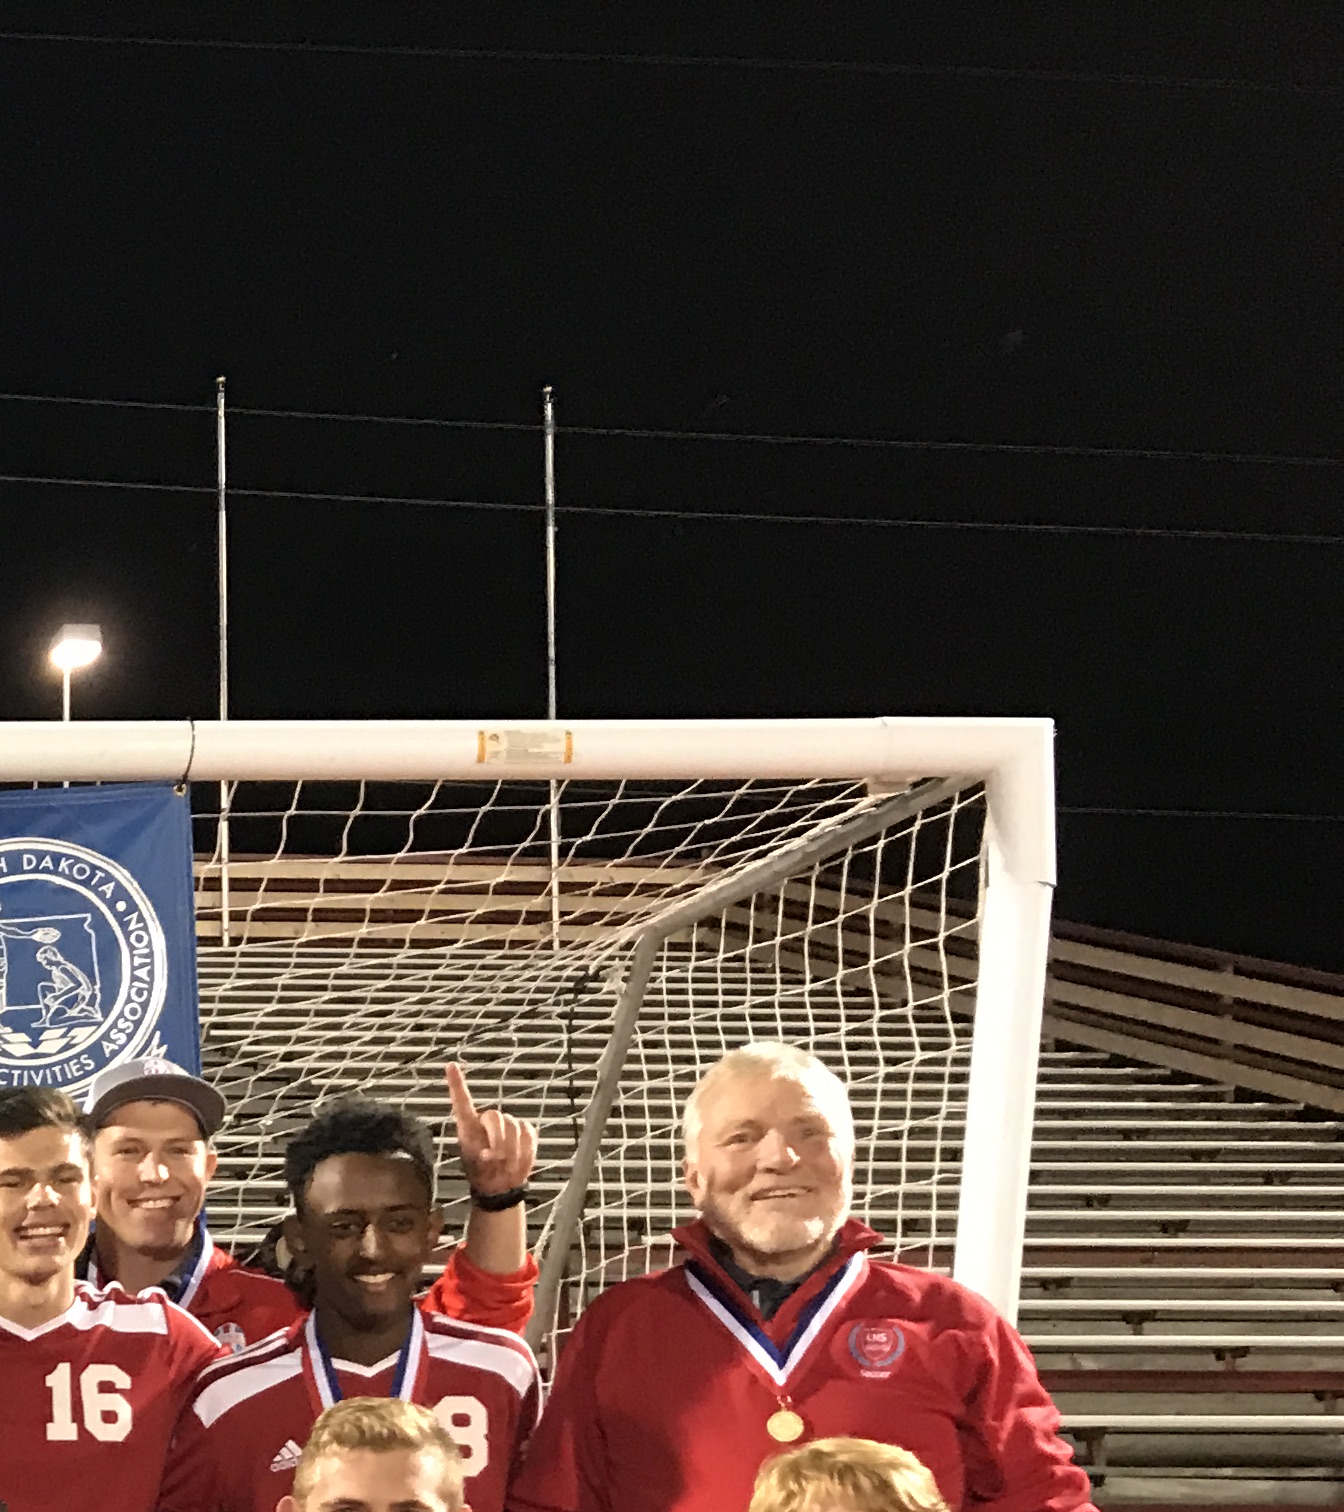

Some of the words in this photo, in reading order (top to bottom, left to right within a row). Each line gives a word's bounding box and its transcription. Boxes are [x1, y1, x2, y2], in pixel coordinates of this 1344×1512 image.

[22, 853, 117, 900] DAKOTA
[101, 910, 152, 1058] ASSOCIATION
[44, 1360, 133, 1444] 16
